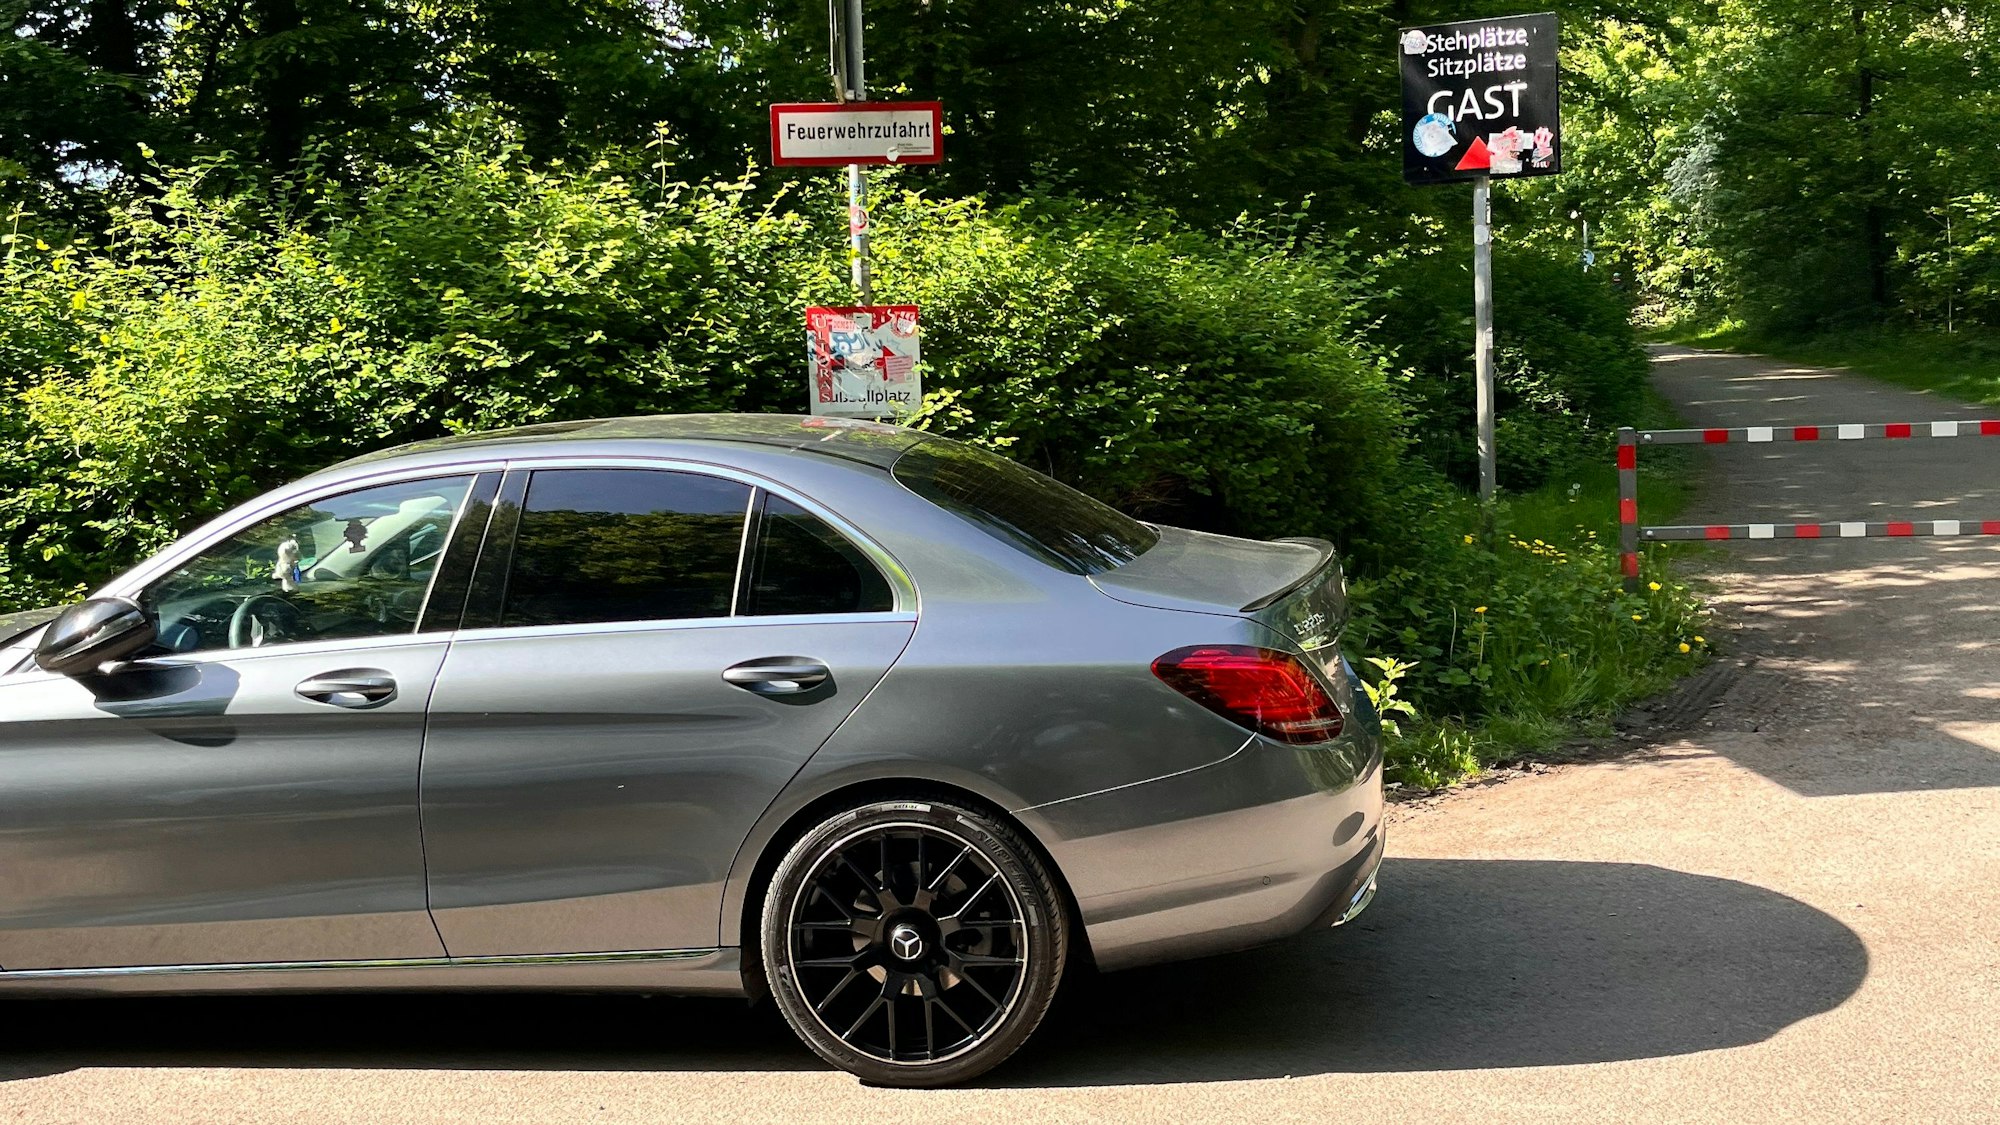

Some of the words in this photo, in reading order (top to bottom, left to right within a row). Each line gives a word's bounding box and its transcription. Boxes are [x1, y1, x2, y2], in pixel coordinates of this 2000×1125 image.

[1426, 26, 1528, 55] Stehplätze
[1427, 52, 1527, 79] Sitzplätze
[1427, 82, 1528, 123] GAST
[787, 121, 931, 140] Feuerwehrzufahrt
